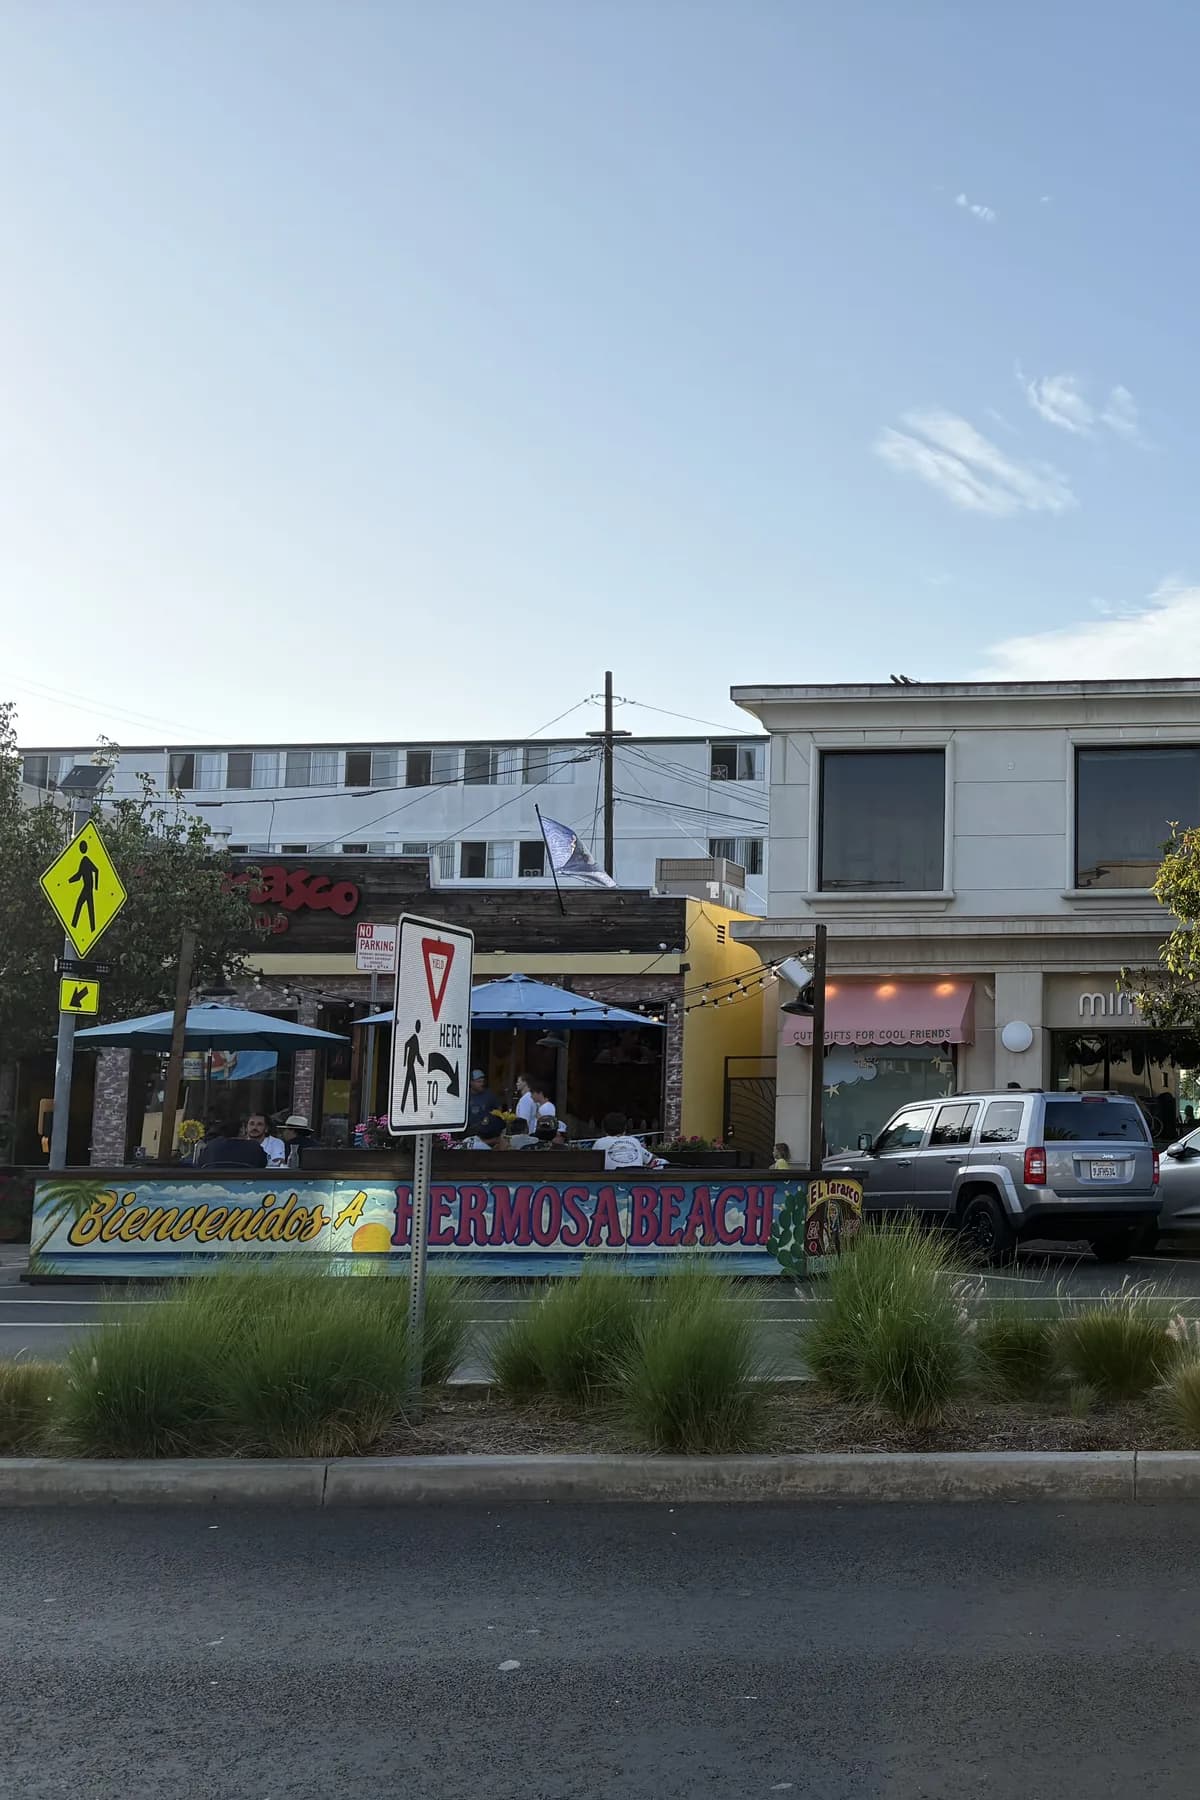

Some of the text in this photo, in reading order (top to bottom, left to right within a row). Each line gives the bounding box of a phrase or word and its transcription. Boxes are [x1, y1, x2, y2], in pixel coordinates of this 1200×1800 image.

[360, 925, 372, 937] NO
[360, 939, 394, 952] PARKING
[431, 958, 445, 970] YIELD
[439, 1023, 463, 1049] HERE
[793, 1029, 951, 1041] CUT GIFTS FOR COOL FRIENDS
[426, 1080, 439, 1106] TO
[67, 1184, 776, 1247] Bienvenidos A HERMOSA BEACH
